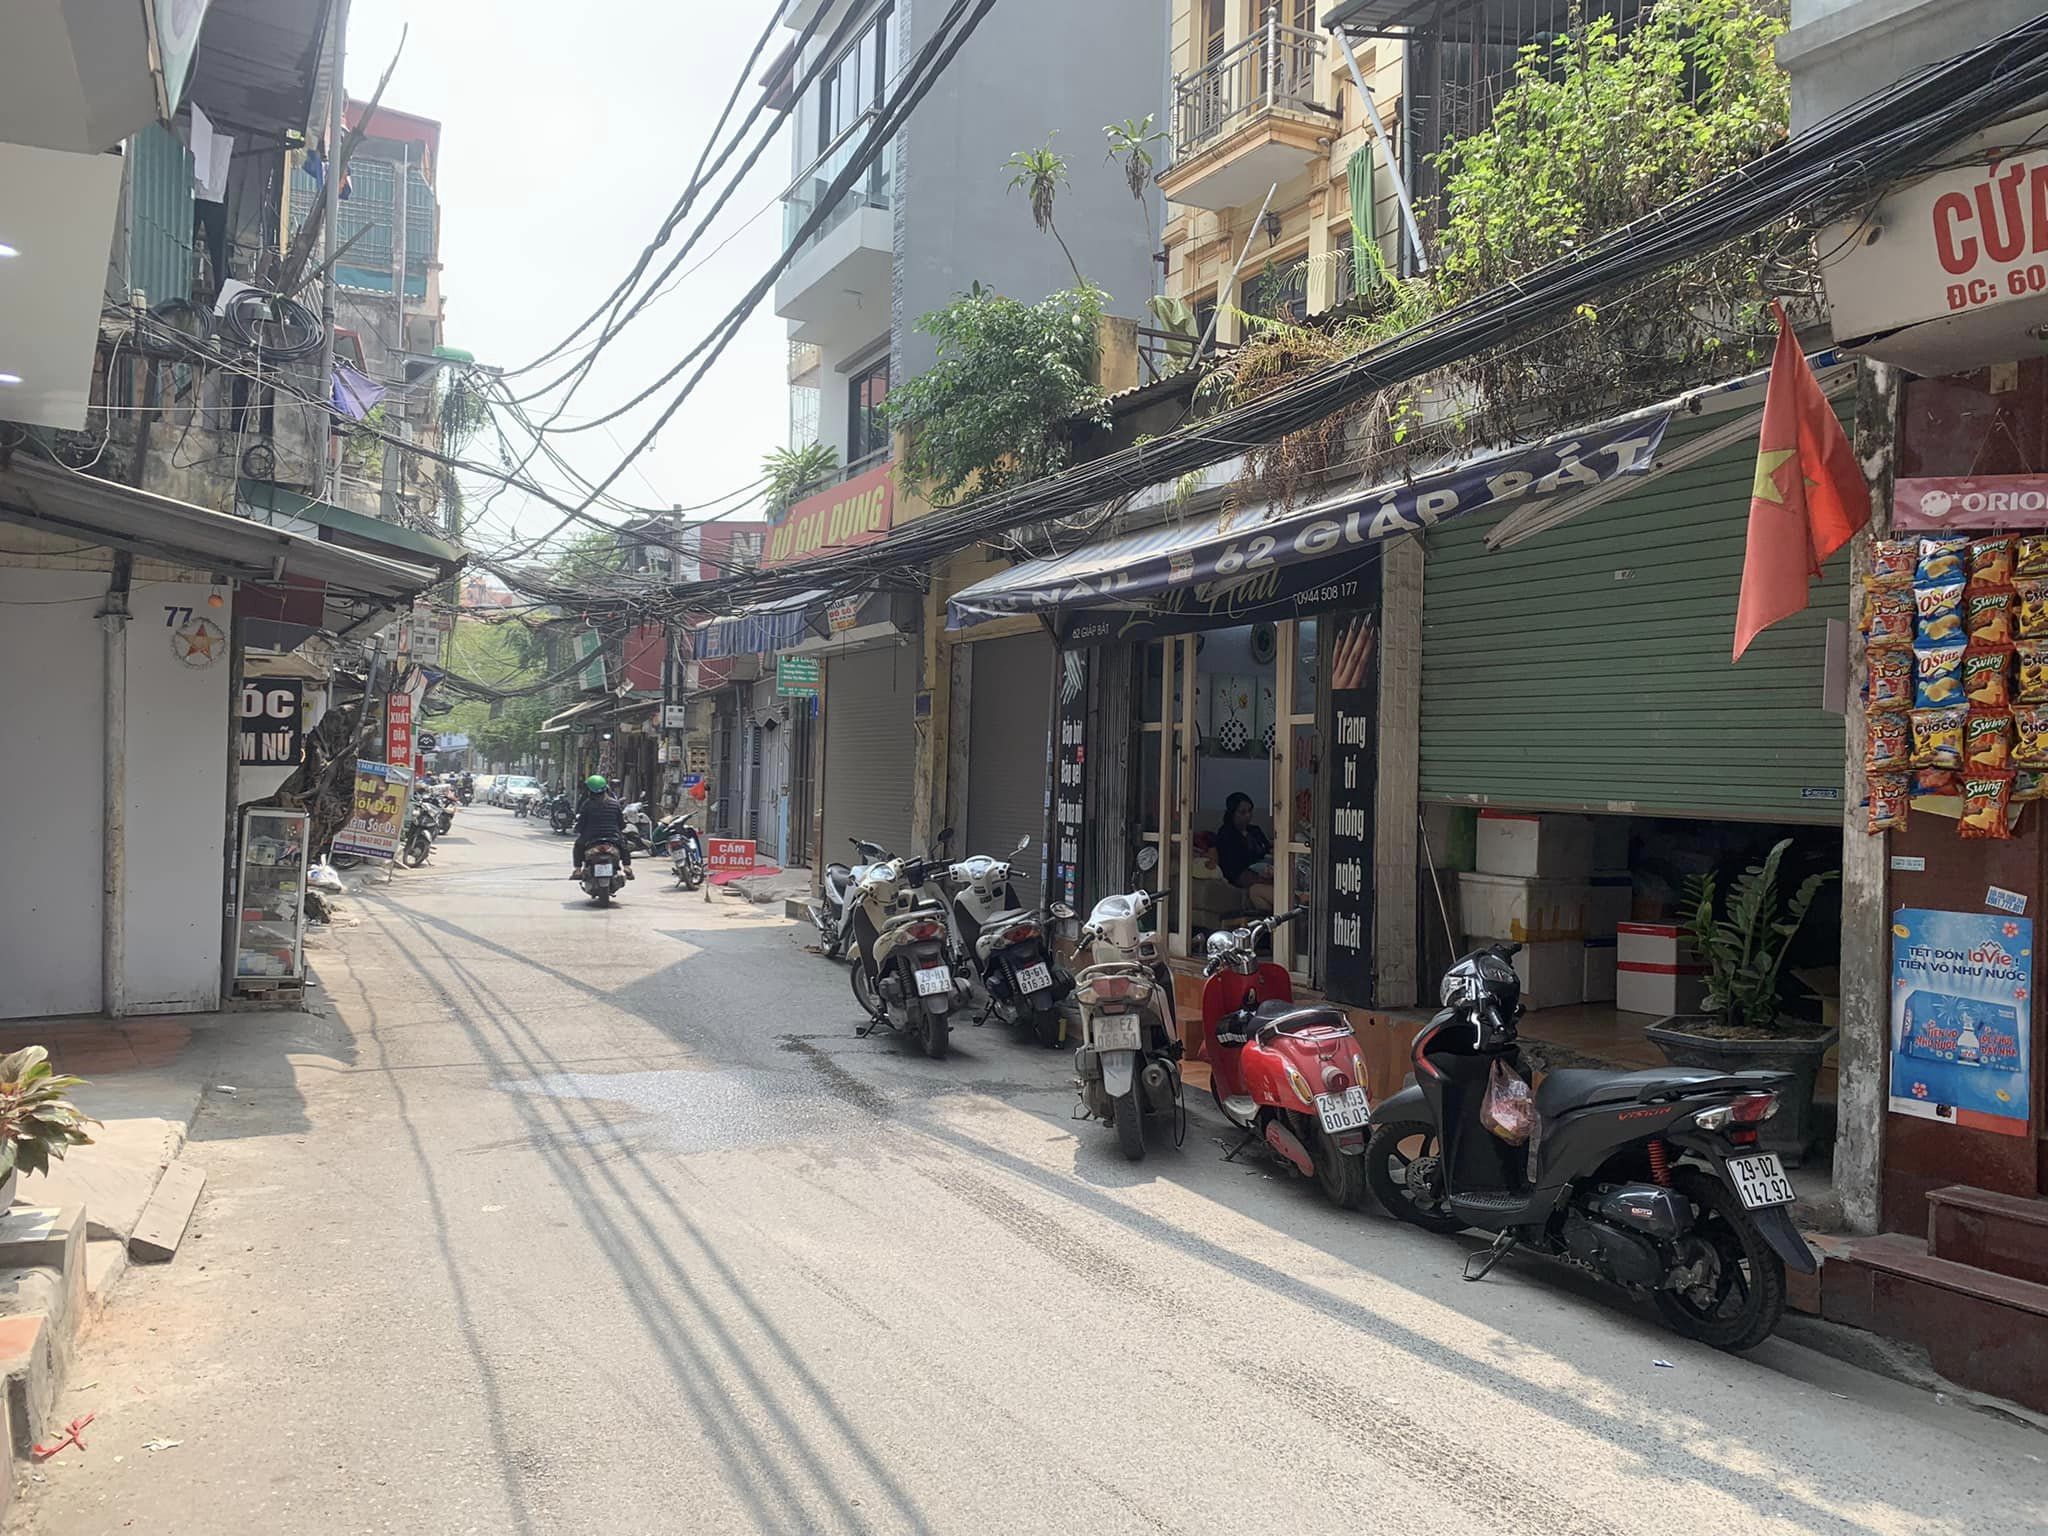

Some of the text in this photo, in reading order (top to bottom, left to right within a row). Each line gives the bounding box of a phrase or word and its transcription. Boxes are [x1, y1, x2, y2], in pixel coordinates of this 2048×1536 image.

[1946, 280, 1997, 310] ĐC:
[1961, 491, 2048, 512] ORIO
[768, 485, 885, 564] ĐỒ GIA DỤNG
[1031, 572, 1139, 605] NAIL
[1214, 535, 1277, 575] 62
[1292, 488, 1460, 554] GIÁP
[1296, 581, 1358, 605] 0944 508 177
[1971, 593, 2009, 615] Swing
[164, 606, 193, 628] 77
[1071, 628, 1081, 640] 62
[1967, 654, 2003, 676] Swing
[1337, 711, 1366, 748] Trang
[1915, 719, 1957, 735] CHOCO
[1970, 718, 2009, 737] Swing
[262, 725, 294, 761] NỮ
[1345, 754, 1356, 789] trí
[1966, 781, 2002, 798] Swing
[1335, 802, 1364, 841] móng
[719, 842, 745, 854] CẤM
[1335, 857, 1362, 900] nghệ
[1334, 911, 1360, 955] thuật
[1909, 943, 1932, 958] TẾT
[1935, 948, 1964, 961] ĐÓN
[1952, 965, 1983, 977] NHƯ
[1985, 968, 2026, 982] NƯỚC
[1324, 1107, 1369, 1130] 806.03
[1736, 1156, 1778, 1181] 29-D2
[1742, 1179, 1794, 1205] 142.92
